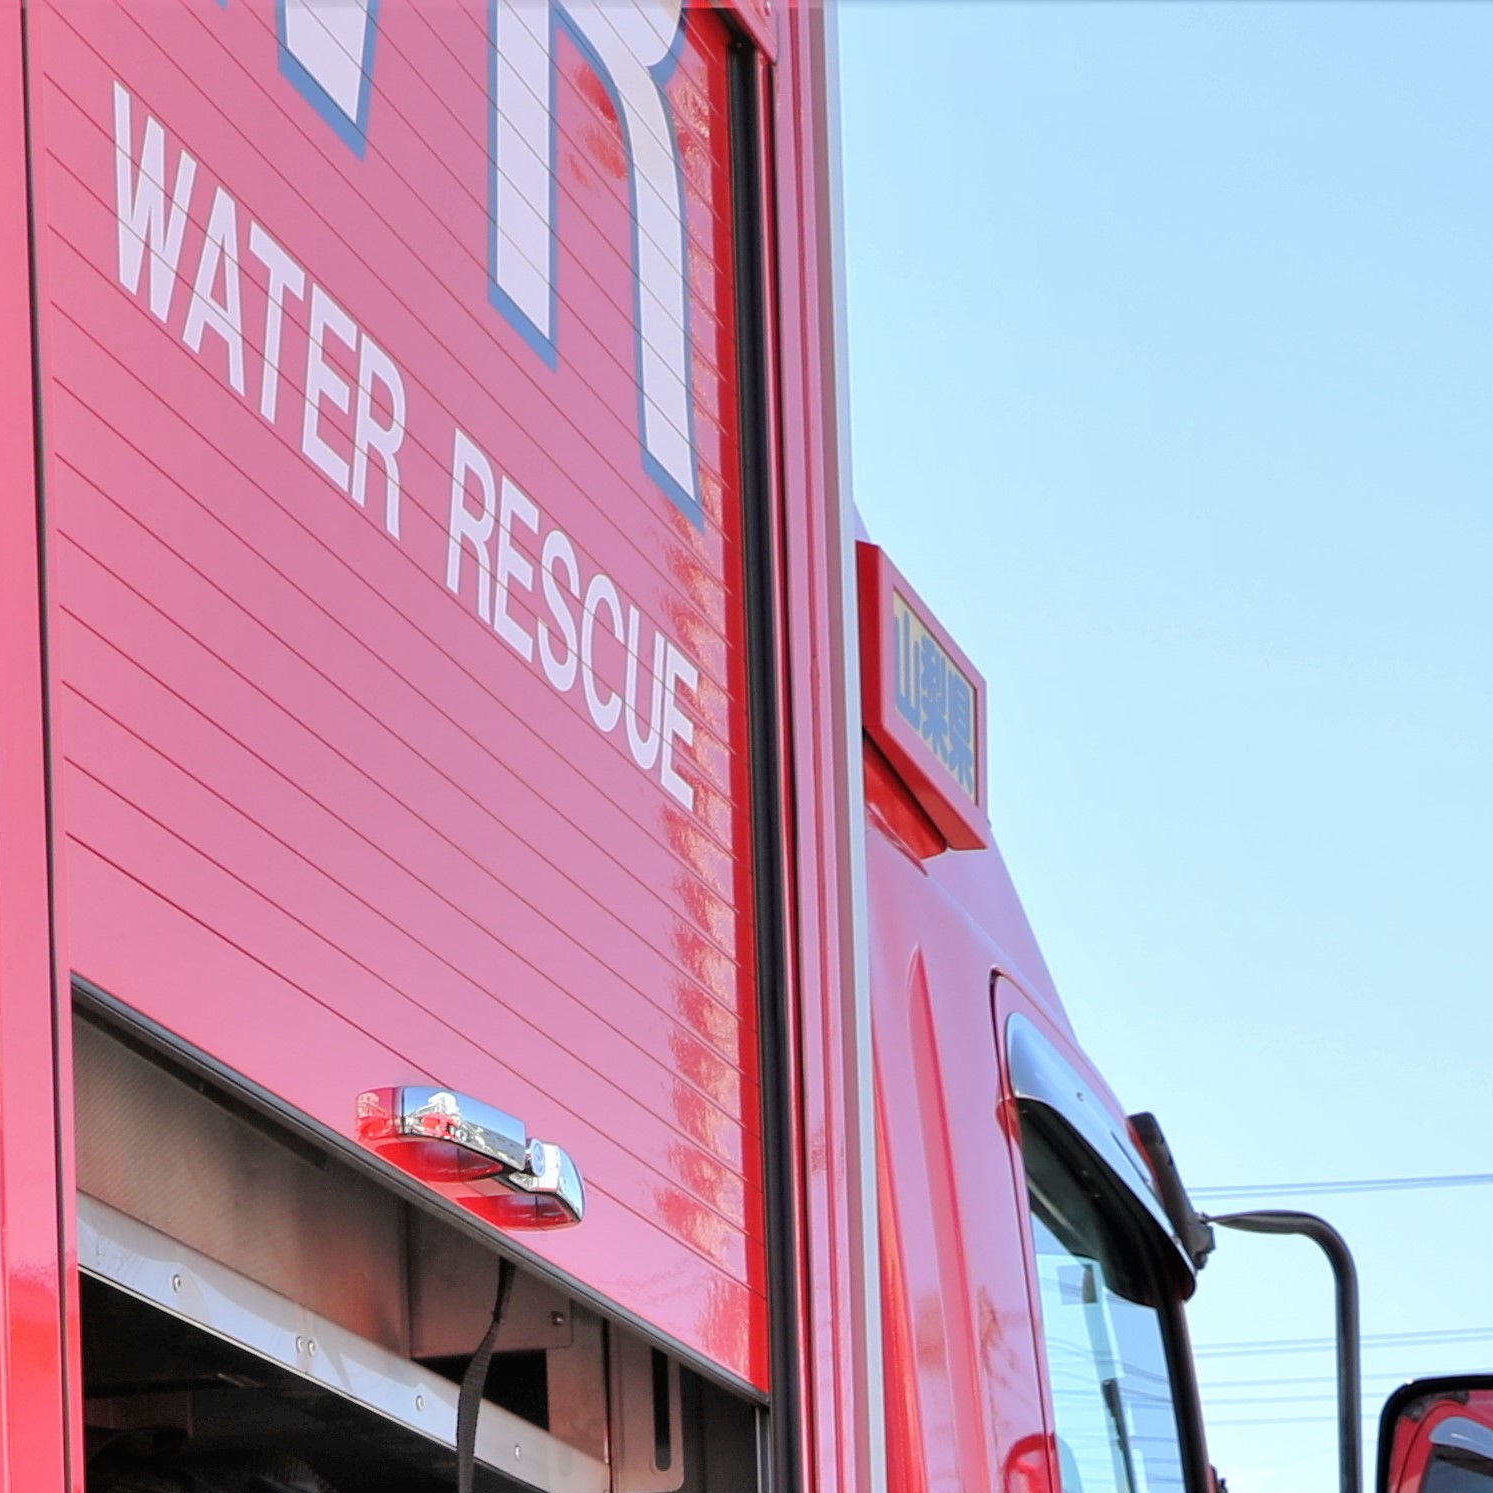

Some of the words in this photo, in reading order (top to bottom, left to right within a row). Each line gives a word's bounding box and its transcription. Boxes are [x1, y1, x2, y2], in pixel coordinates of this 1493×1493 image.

[112, 80, 407, 542] WATER
[445, 427, 700, 812] RESCUE
[894, 609, 973, 797] 山梨県
